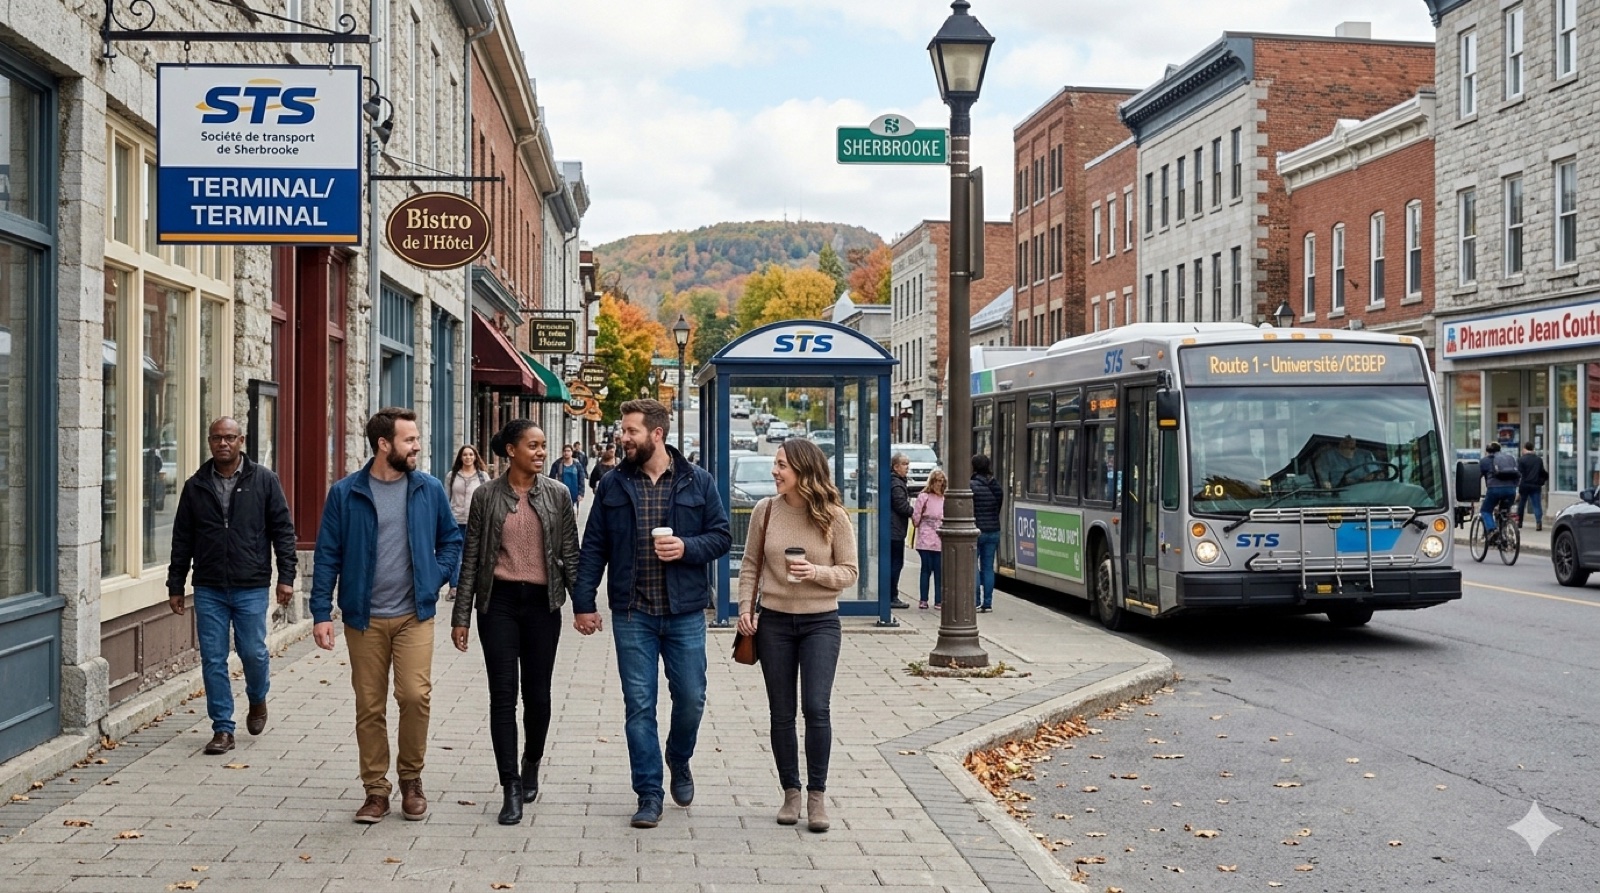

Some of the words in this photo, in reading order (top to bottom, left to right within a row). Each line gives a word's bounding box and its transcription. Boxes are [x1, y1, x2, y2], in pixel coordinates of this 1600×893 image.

[202, 87, 316, 124] STS
[201, 131, 242, 142] Société
[245, 131, 260, 142] de
[262, 132, 315, 144] transport
[216, 144, 231, 155] de
[234, 144, 299, 155] Sherbrooke
[843, 139, 941, 157] SHERBROOKE
[187, 177, 335, 198] TERMINAL/
[190, 205, 328, 226] TERMINAL
[406, 208, 472, 230] Bistro
[402, 234, 420, 250] de
[423, 234, 474, 250] l'Hôtel
[773, 334, 834, 353] STS
[1460, 319, 1525, 350] Pharmacie
[1528, 318, 1560, 342] Jean
[1210, 356, 1249, 374] Route
[1251, 355, 1259, 373] 1
[1236, 533, 1280, 548] STS
